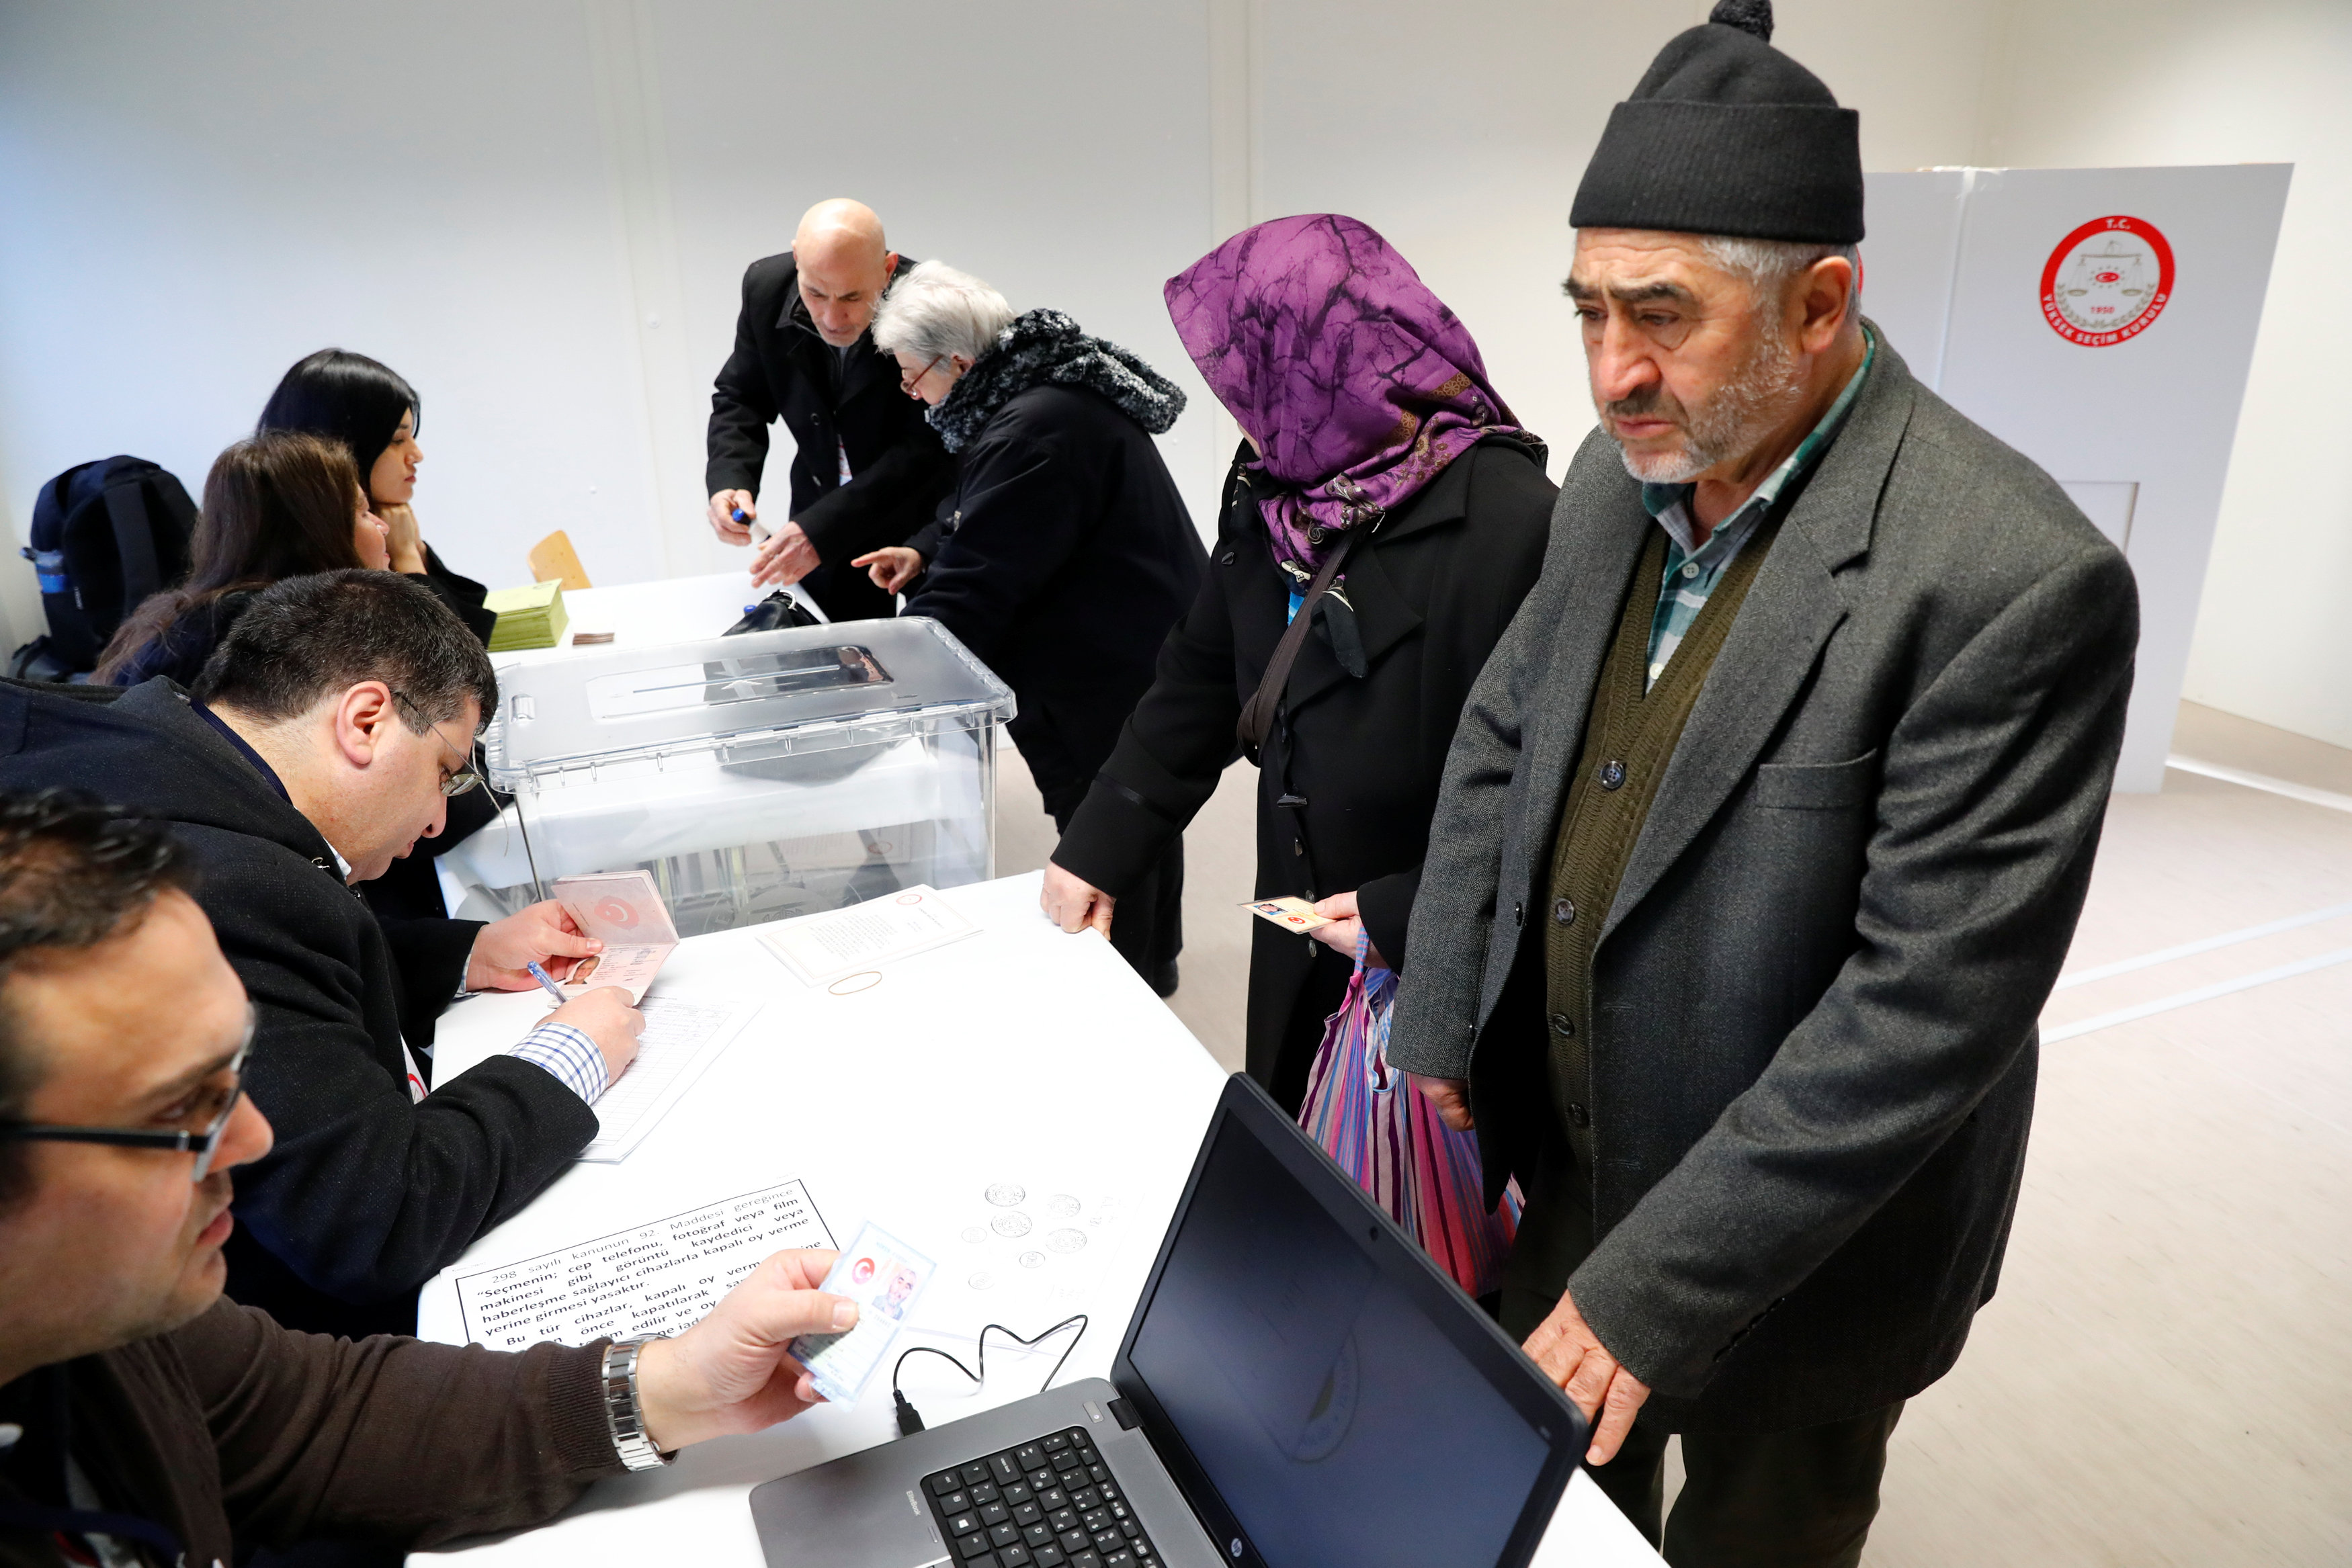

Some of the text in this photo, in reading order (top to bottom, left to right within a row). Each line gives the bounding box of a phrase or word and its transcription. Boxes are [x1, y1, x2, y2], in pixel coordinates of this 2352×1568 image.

[2105, 217, 2131, 230] T.C.
[2075, 333, 2118, 347] SEÇİM
[2122, 293, 2168, 339] KURULU
[479, 1209, 804, 1311] makinesi gibi görüntü kaydedici veya
[491, 1188, 794, 1284] 298 sayılı kanunun 92. Maddesi gereğince
[568, 1262, 592, 1274] cep
[601, 1242, 663, 1263] telefonu,
[672, 1219, 726, 1241] fotoğraf
[734, 1209, 765, 1223] veya
[773, 1199, 798, 1211] film
[482, 1217, 810, 1323] haberleşme sağlayıcı cihazlarla kapalı oy verme
[484, 1281, 650, 1337] yerine girmesi yasaktır.
[506, 1335, 526, 1346] Bu
[539, 1323, 561, 1336] tür
[574, 1303, 633, 1325] cihazlar,
[644, 1284, 687, 1302] kapalı
[699, 1274, 715, 1286] oy
[581, 1289, 710, 1335] önce kapatılarak
[631, 1299, 717, 1332] edilir ve oy
[1050, 1491, 1059, 1499] W
